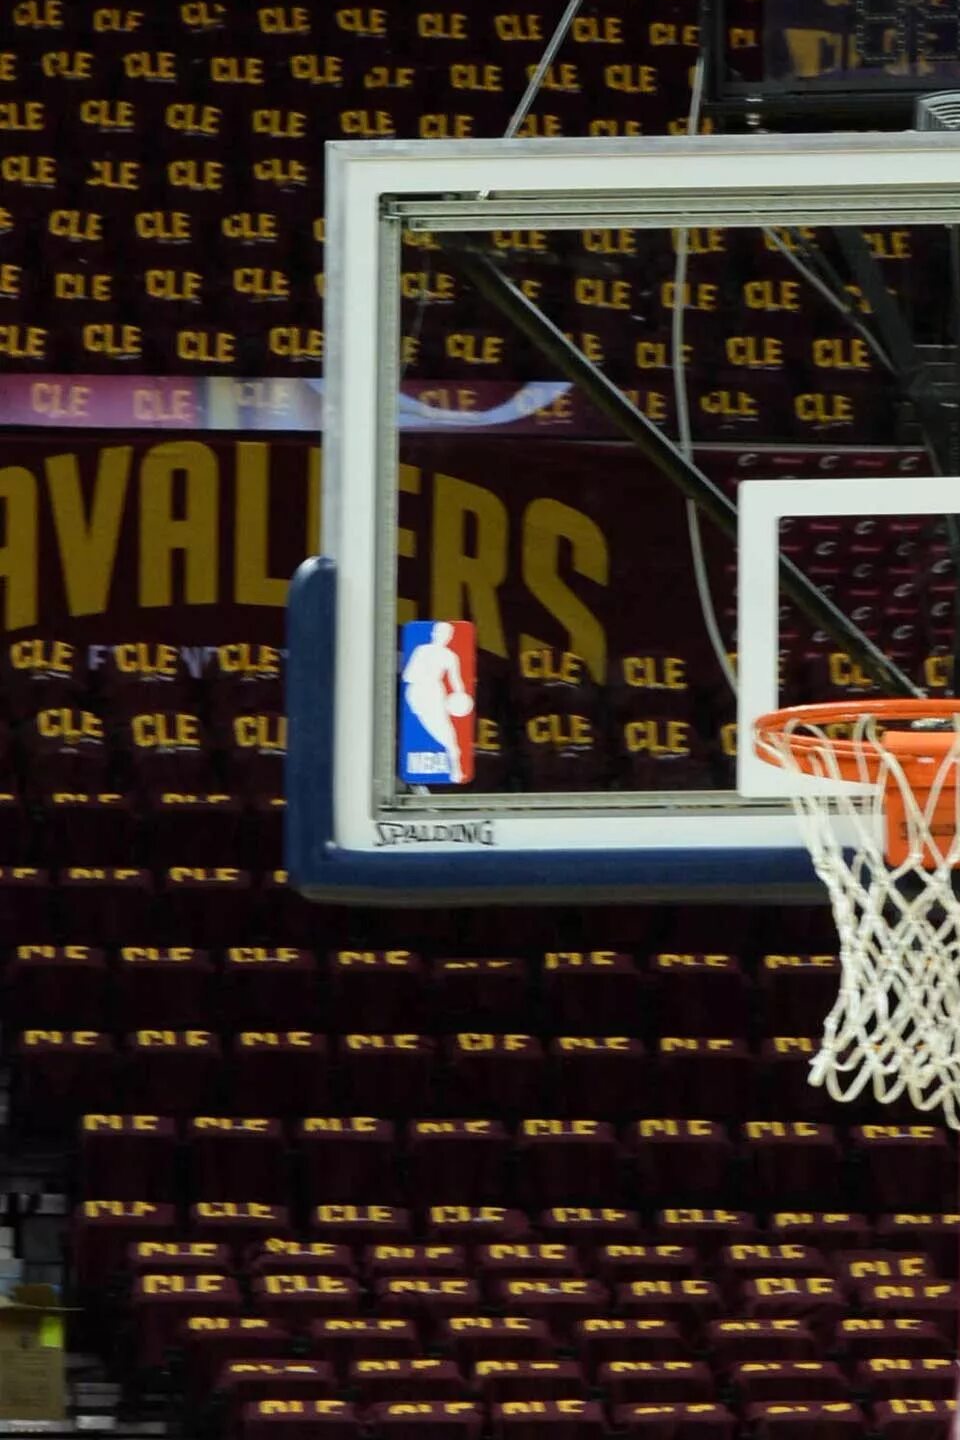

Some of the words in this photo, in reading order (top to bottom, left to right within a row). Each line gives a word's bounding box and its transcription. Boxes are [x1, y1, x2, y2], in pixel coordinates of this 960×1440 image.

[13, 0, 64, 26] CLE
[258, 8, 311, 33] CLE
[335, 9, 386, 33] CLE
[417, 13, 467, 39] CLE
[494, 15, 543, 40] CLE
[571, 17, 624, 43] CLE
[123, 52, 177, 78] CLE
[210, 58, 263, 84] CLE
[290, 55, 343, 83] CLE
[450, 64, 503, 91] CLE
[605, 65, 656, 92] CLE
[80, 100, 135, 127] CLE
[165, 104, 220, 133] CLE
[252, 110, 305, 137] CLE
[340, 111, 395, 136] CLE
[419, 115, 473, 139] CLE
[0, 156, 57, 184] CLE
[167, 160, 224, 190] CLE
[253, 159, 307, 182] CLE
[48, 210, 102, 240] CLE
[134, 211, 191, 239] CLE
[221, 213, 279, 239] CLE
[582, 225, 637, 254] CLE
[55, 273, 113, 301] CLE
[145, 270, 202, 300] CLE
[233, 268, 290, 297] CLE
[574, 278, 631, 309] CLE
[743, 281, 800, 310] CLE
[82, 324, 142, 357] CLE
[177, 331, 236, 362] CLE
[445, 334, 504, 363] CLE
[725, 337, 782, 366] CLE
[812, 339, 870, 368] CLE
[32, 382, 90, 418] CLE
[133, 389, 193, 422] CLE
[794, 394, 854, 422] CLE
[9, 639, 74, 671] CLE
[114, 643, 178, 676] CLE
[217, 643, 281, 676] CLE
[520, 647, 582, 684] CLE
[622, 657, 689, 689] CLE
[36, 708, 104, 743] CLE
[131, 713, 202, 748] CLE
[526, 714, 594, 745] CLE
[623, 720, 690, 755] CLE
[375, 821, 497, 847] SPALDING
